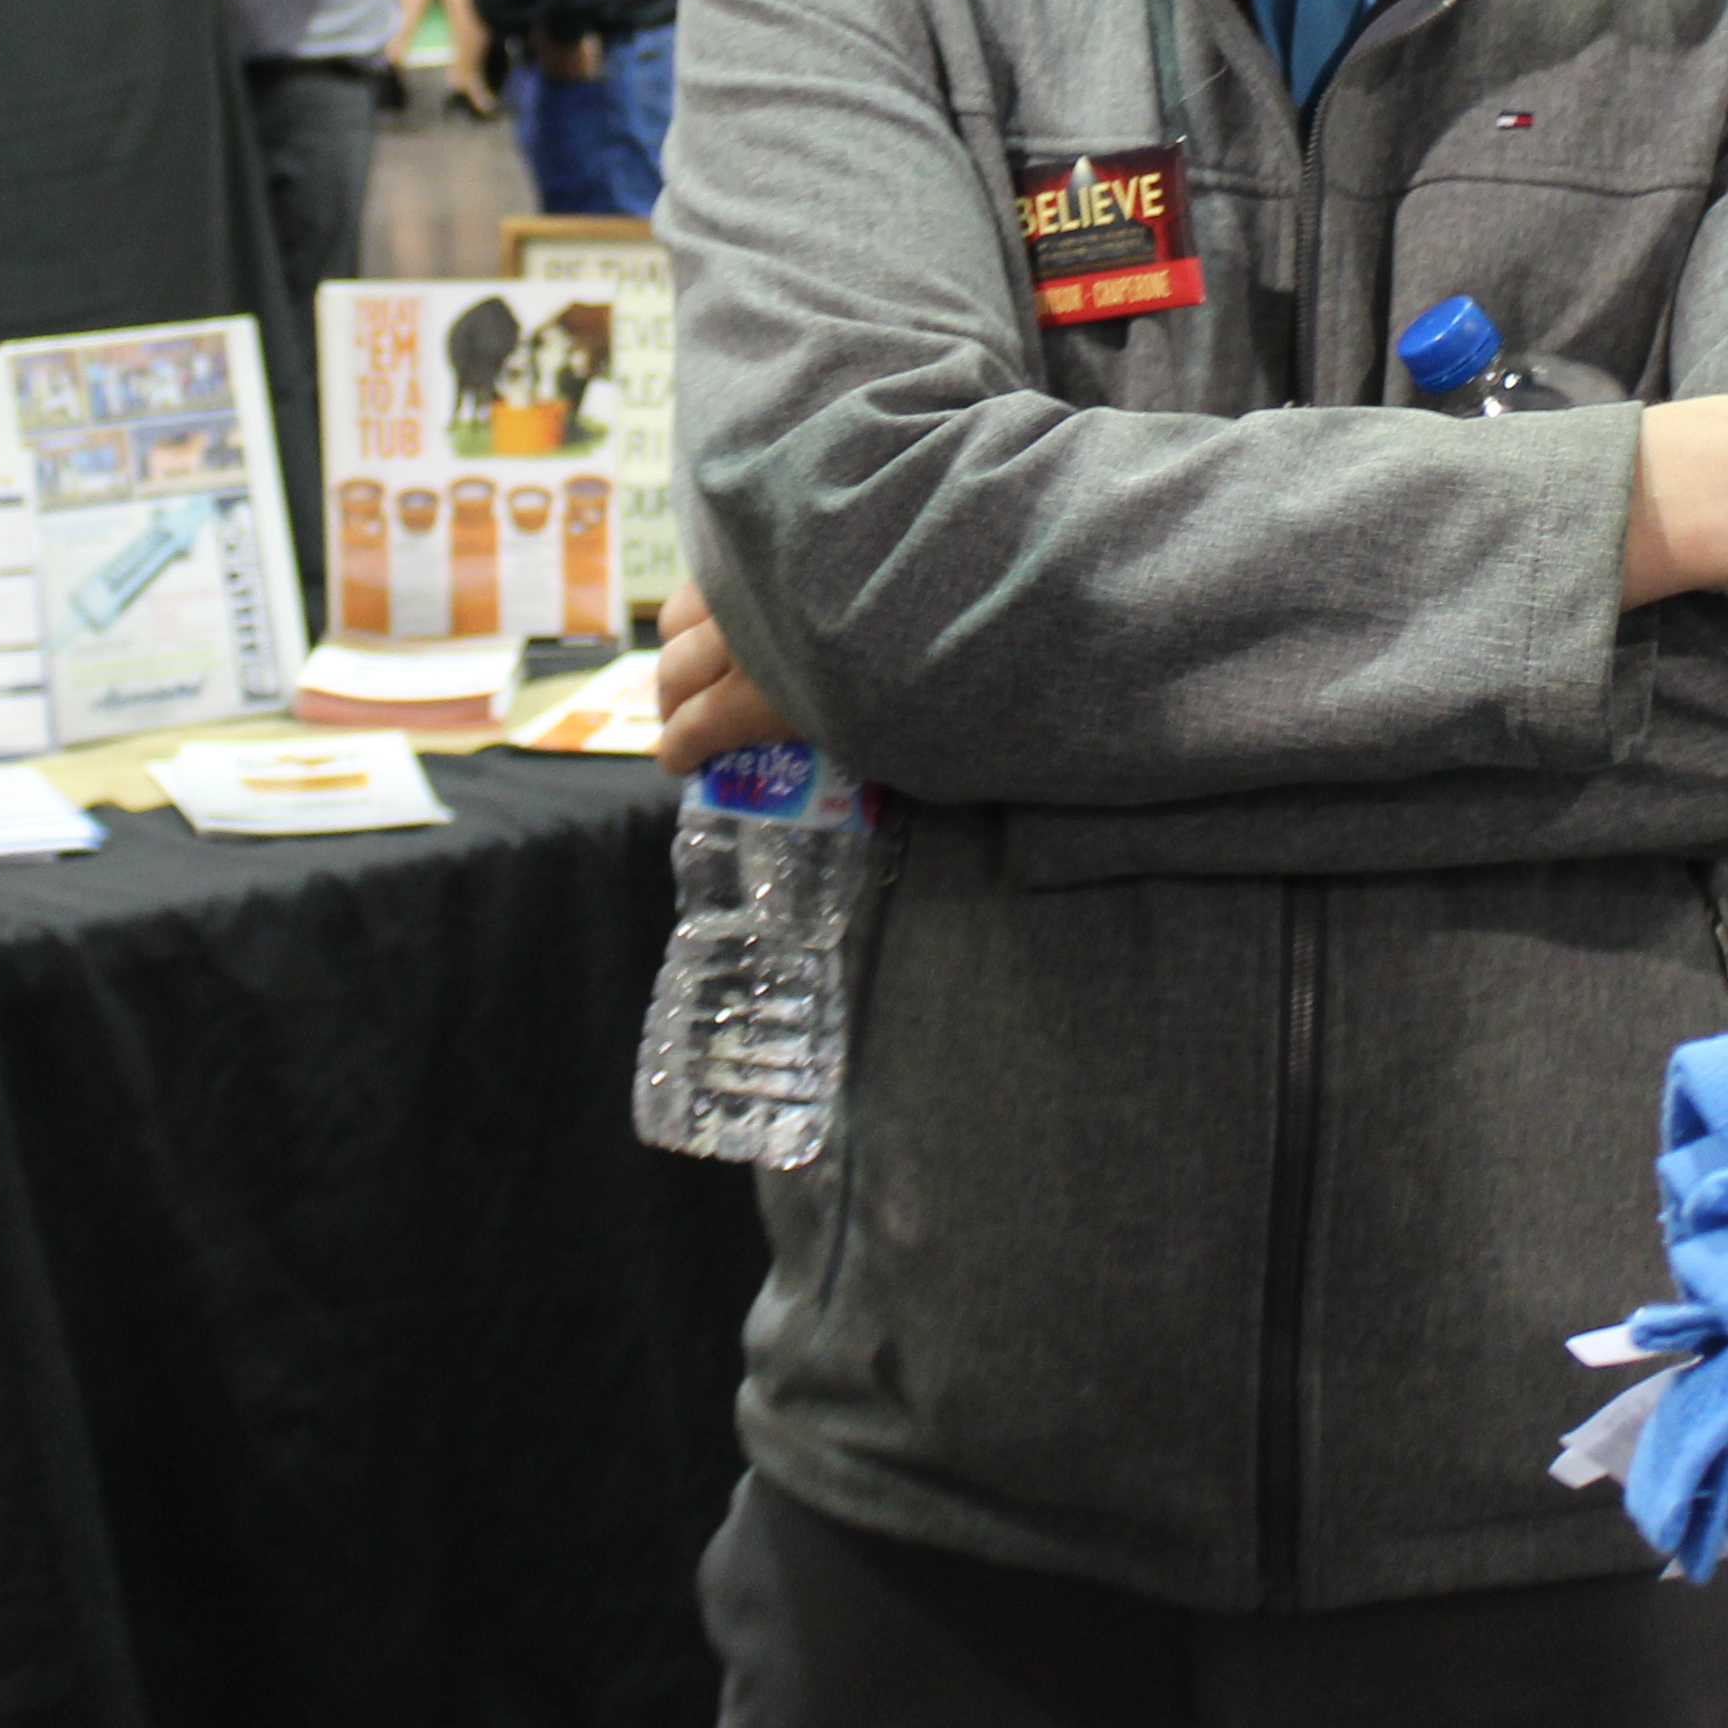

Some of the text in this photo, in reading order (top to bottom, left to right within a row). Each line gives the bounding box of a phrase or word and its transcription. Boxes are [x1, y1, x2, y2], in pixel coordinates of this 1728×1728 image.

[1014, 172, 1165, 238] BELIEVE
[356, 376, 394, 414] TO
[358, 418, 422, 460] TUB
